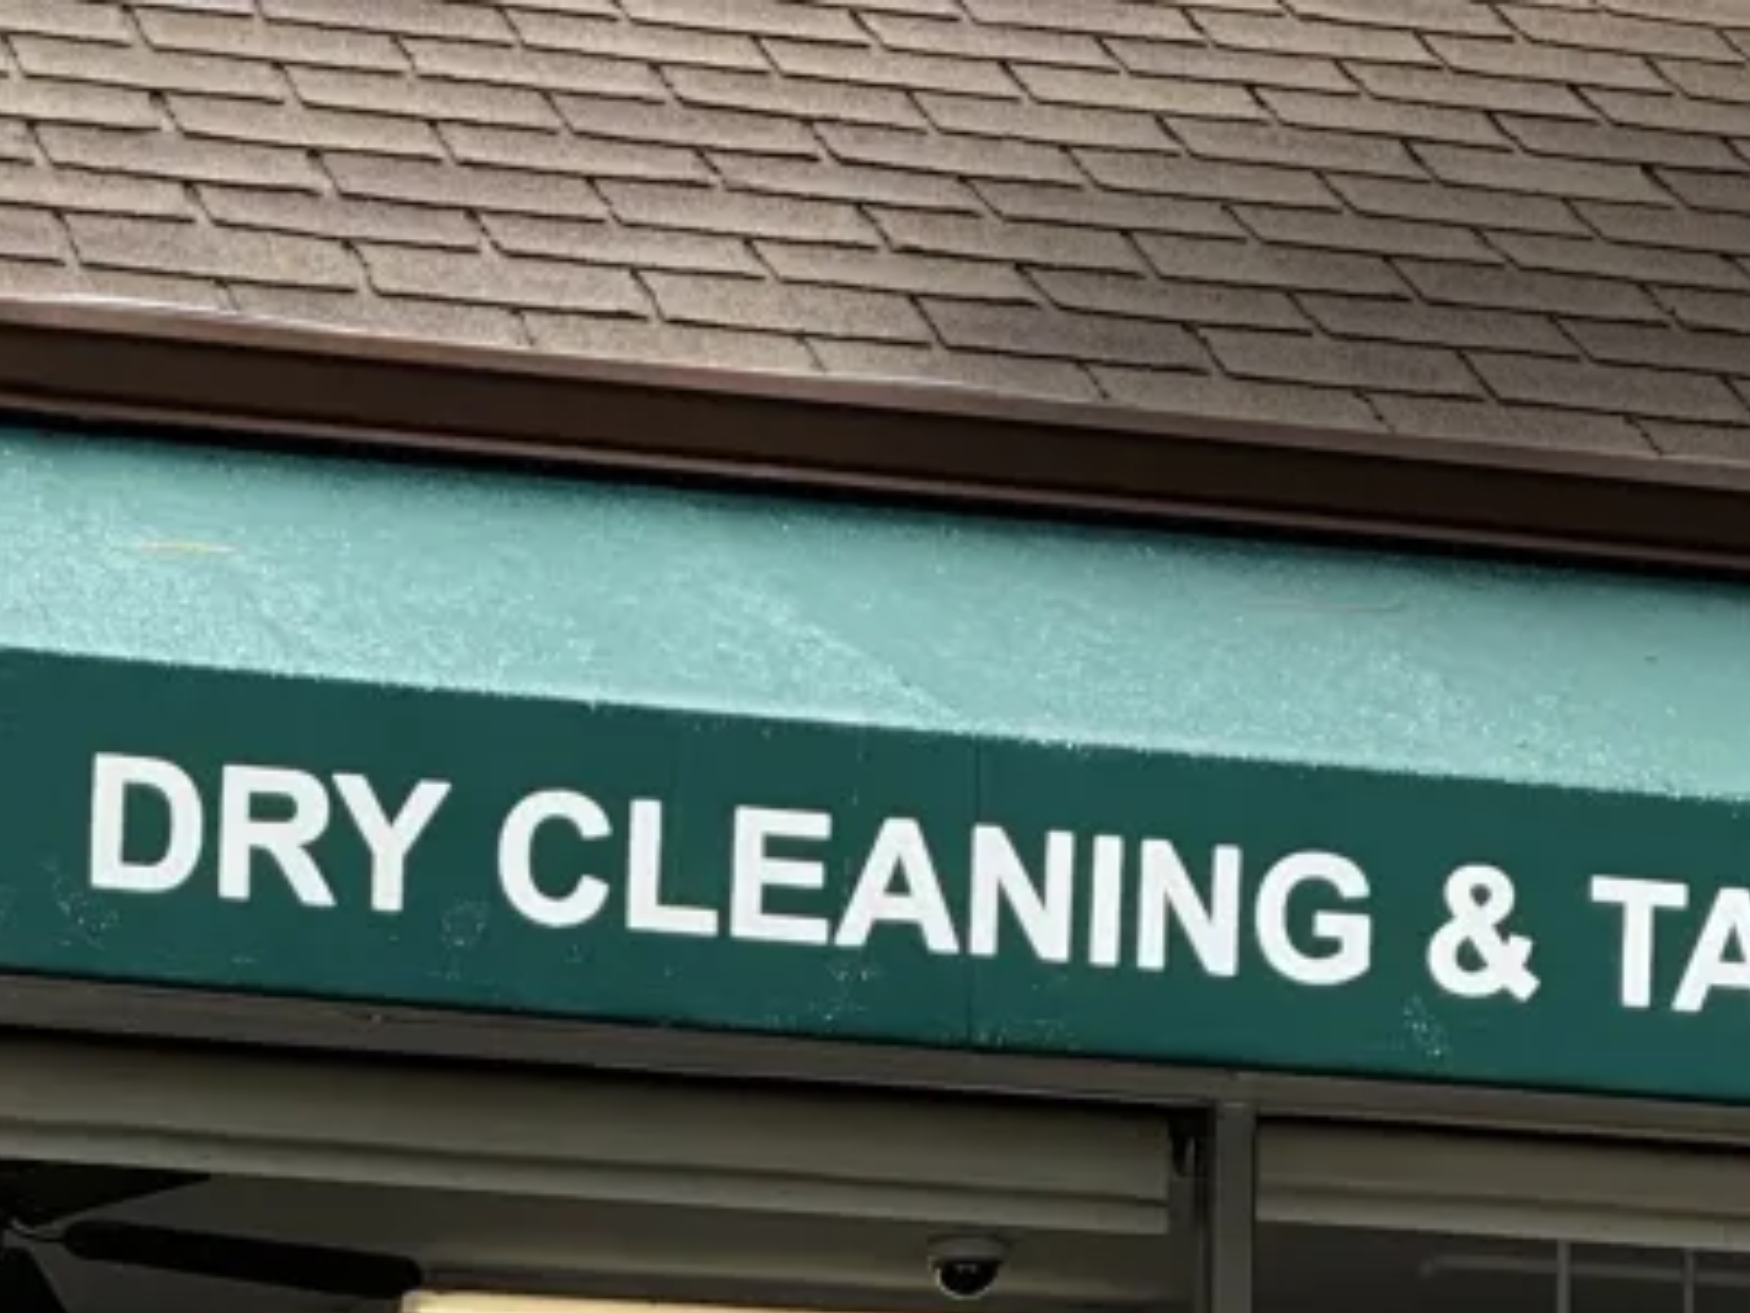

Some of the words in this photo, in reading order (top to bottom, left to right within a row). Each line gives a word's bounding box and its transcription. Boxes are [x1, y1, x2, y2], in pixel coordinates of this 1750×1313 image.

[90, 750, 451, 913] DRY
[498, 789, 1372, 985] CLEANING
[1425, 863, 1541, 1003] &
